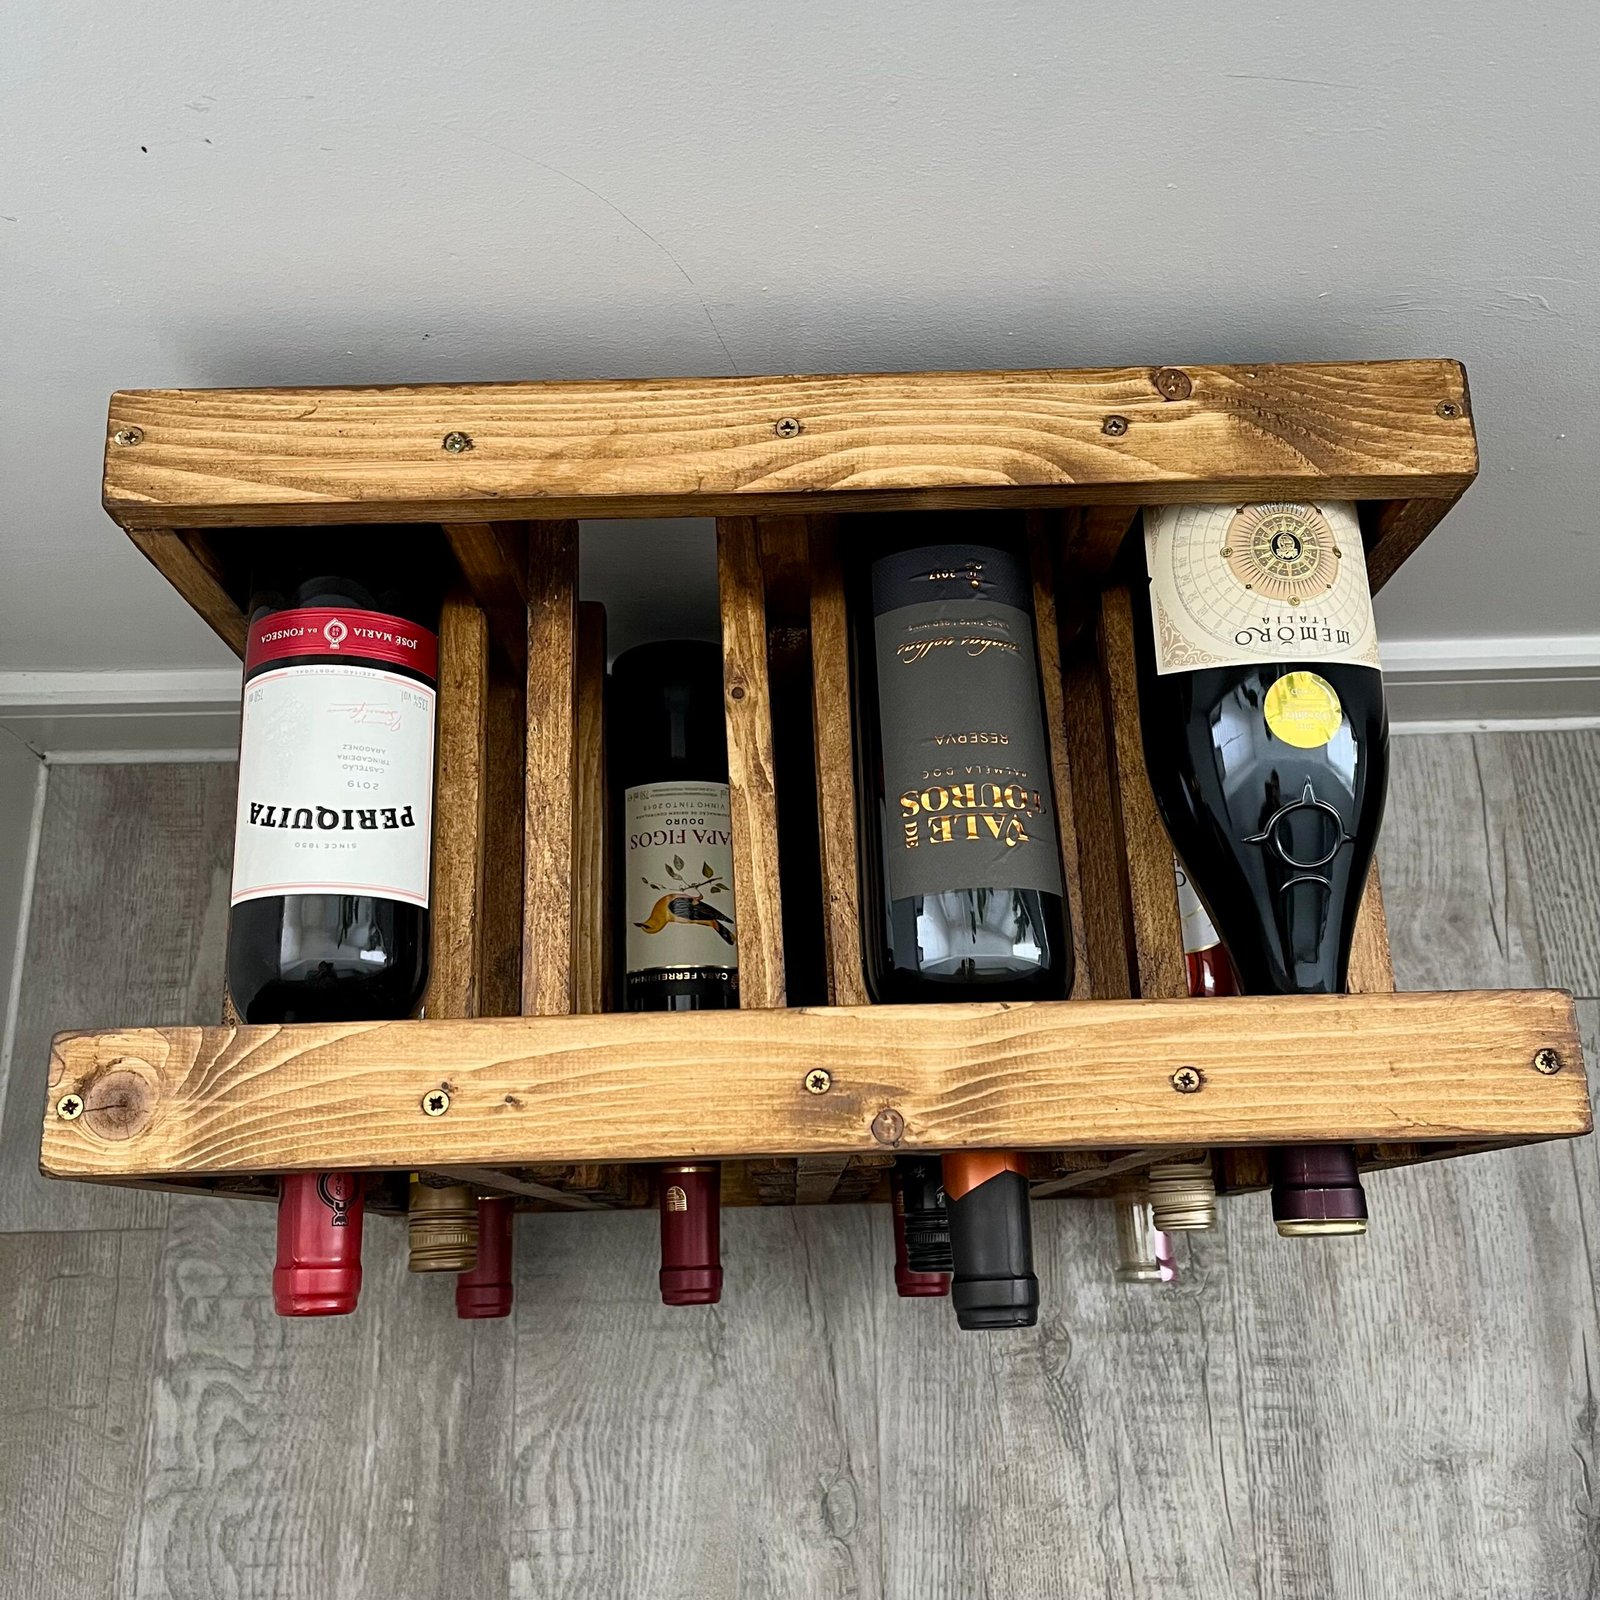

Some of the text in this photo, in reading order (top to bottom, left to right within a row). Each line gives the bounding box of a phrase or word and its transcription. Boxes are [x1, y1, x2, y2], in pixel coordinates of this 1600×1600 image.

[261, 627, 304, 643] FONSECA
[353, 627, 392, 642] MARIA
[395, 635, 418, 650] JOSÉ
[896, 637, 955, 664] velhas
[934, 732, 1008, 745] RESERVA
[342, 744, 386, 755] ARAGONEZ
[337, 754, 390, 765] TRINCADEIRA
[342, 763, 385, 774] CASTELÃO
[922, 766, 1027, 779] PALMELA DOC
[346, 779, 379, 790] 2019
[697, 802, 725, 810] VINHO
[900, 783, 1045, 818] TOUROS
[249, 802, 415, 830] PERIQUITA
[905, 822, 918, 849] DE
[927, 813, 1030, 848] VALE
[324, 842, 357, 850] SINCE
[631, 830, 731, 849] APA FIGOS
[630, 972, 728, 984] CASA FERREIRINHA
